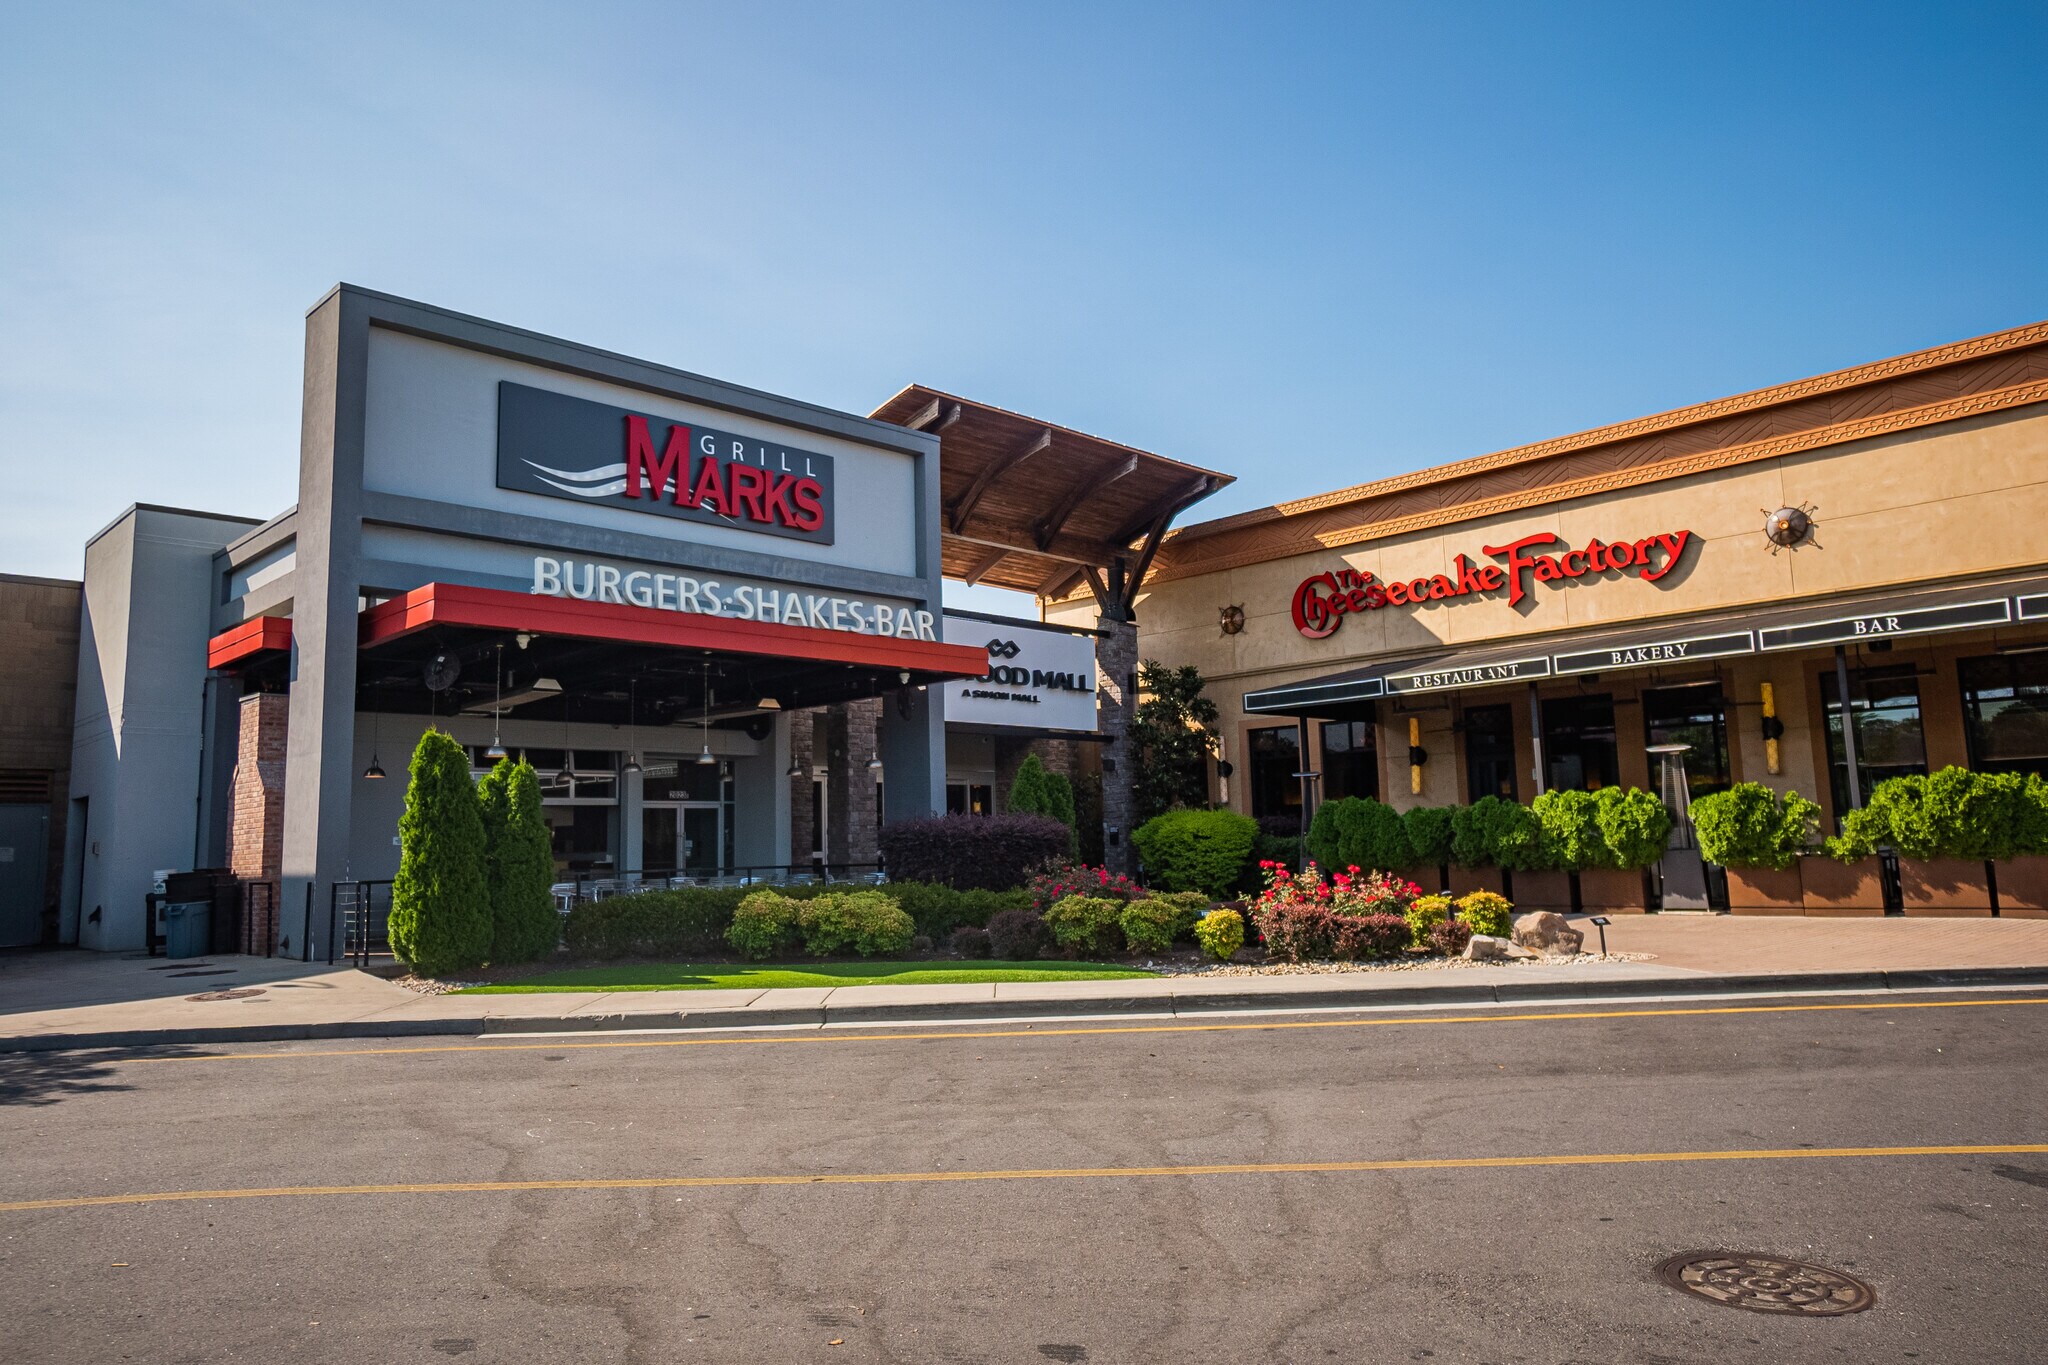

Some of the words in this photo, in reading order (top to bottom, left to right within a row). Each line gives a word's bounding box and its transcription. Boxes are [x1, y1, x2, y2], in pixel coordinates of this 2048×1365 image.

[700, 434, 817, 478] GRILL
[624, 414, 825, 532] MARKS
[1291, 552, 1501, 640] Cheesecake
[1481, 529, 1692, 608] Factory
[1334, 568, 1374, 589] The
[1853, 616, 1902, 635] BAR
[1611, 642, 1690, 665] BAKERY
[1032, 669, 1095, 693] MALL
[1412, 663, 1520, 689] RESTAURANT
[961, 689, 972, 698] A
[972, 689, 1010, 701] SIMON
[1011, 693, 1042, 704] MALL
